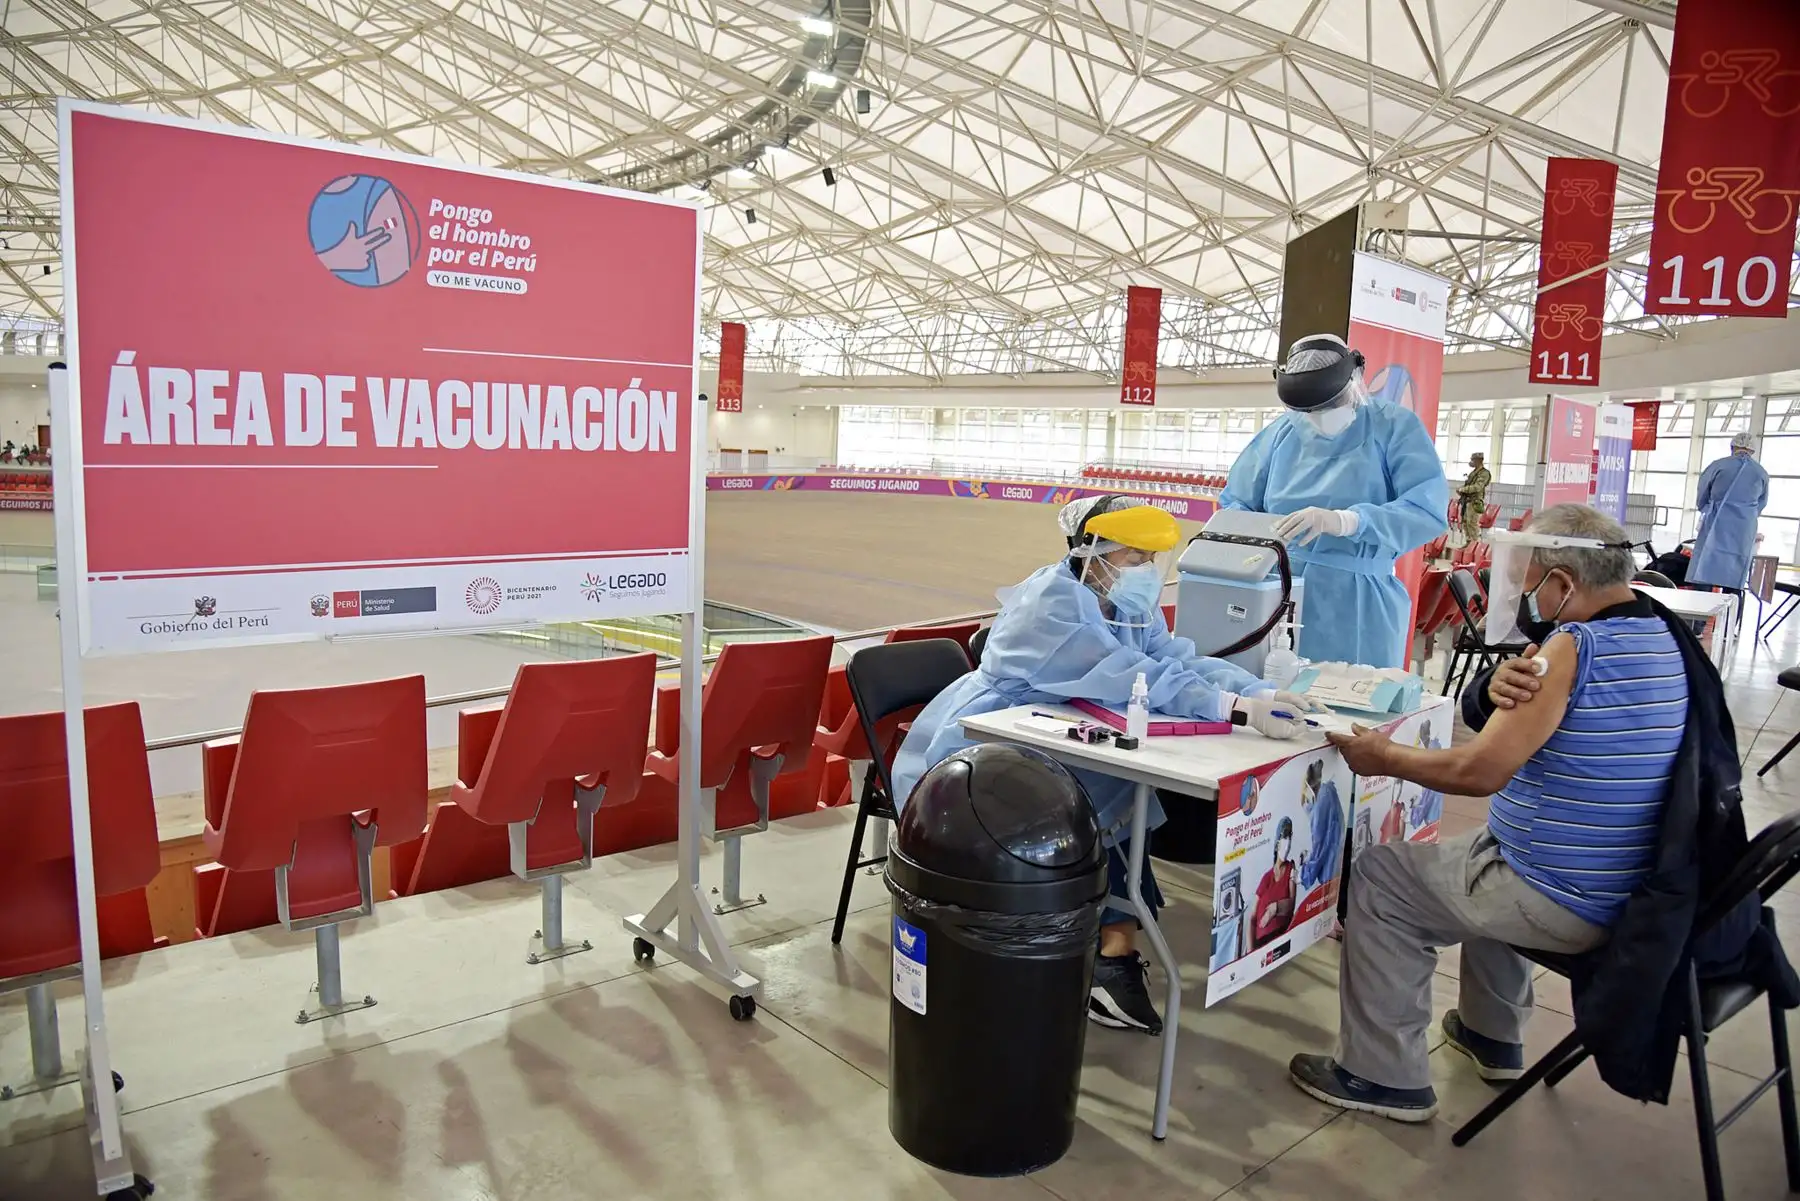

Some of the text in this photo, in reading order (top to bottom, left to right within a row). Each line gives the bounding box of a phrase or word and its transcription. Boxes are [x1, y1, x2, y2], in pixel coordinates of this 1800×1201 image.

[429, 198, 493, 228] Pongo
[429, 222, 531, 250] el hombro
[427, 247, 537, 272] por el Perú
[434, 274, 522, 291] YO ME VACUNO
[1659, 255, 1777, 307] 110
[1536, 351, 1593, 380] 111
[104, 350, 678, 452] ÁREA DE VACUNACIÓN
[1123, 386, 1152, 403] 112
[719, 398, 741, 411] 113
[830, 478, 920, 491] SEGUIMOS JUGANDO
[0, 500, 41, 509] EGUIMOS
[1151, 498, 1188, 515] JUGANDO
[507, 585, 557, 594] BICENTENARIO
[336, 598, 358, 609] PERÚ
[374, 604, 391, 612] Salud
[140, 614, 269, 635] Gobierno del Perú
[1226, 824, 1243, 838] Pongo
[1250, 812, 1272, 826] hombro
